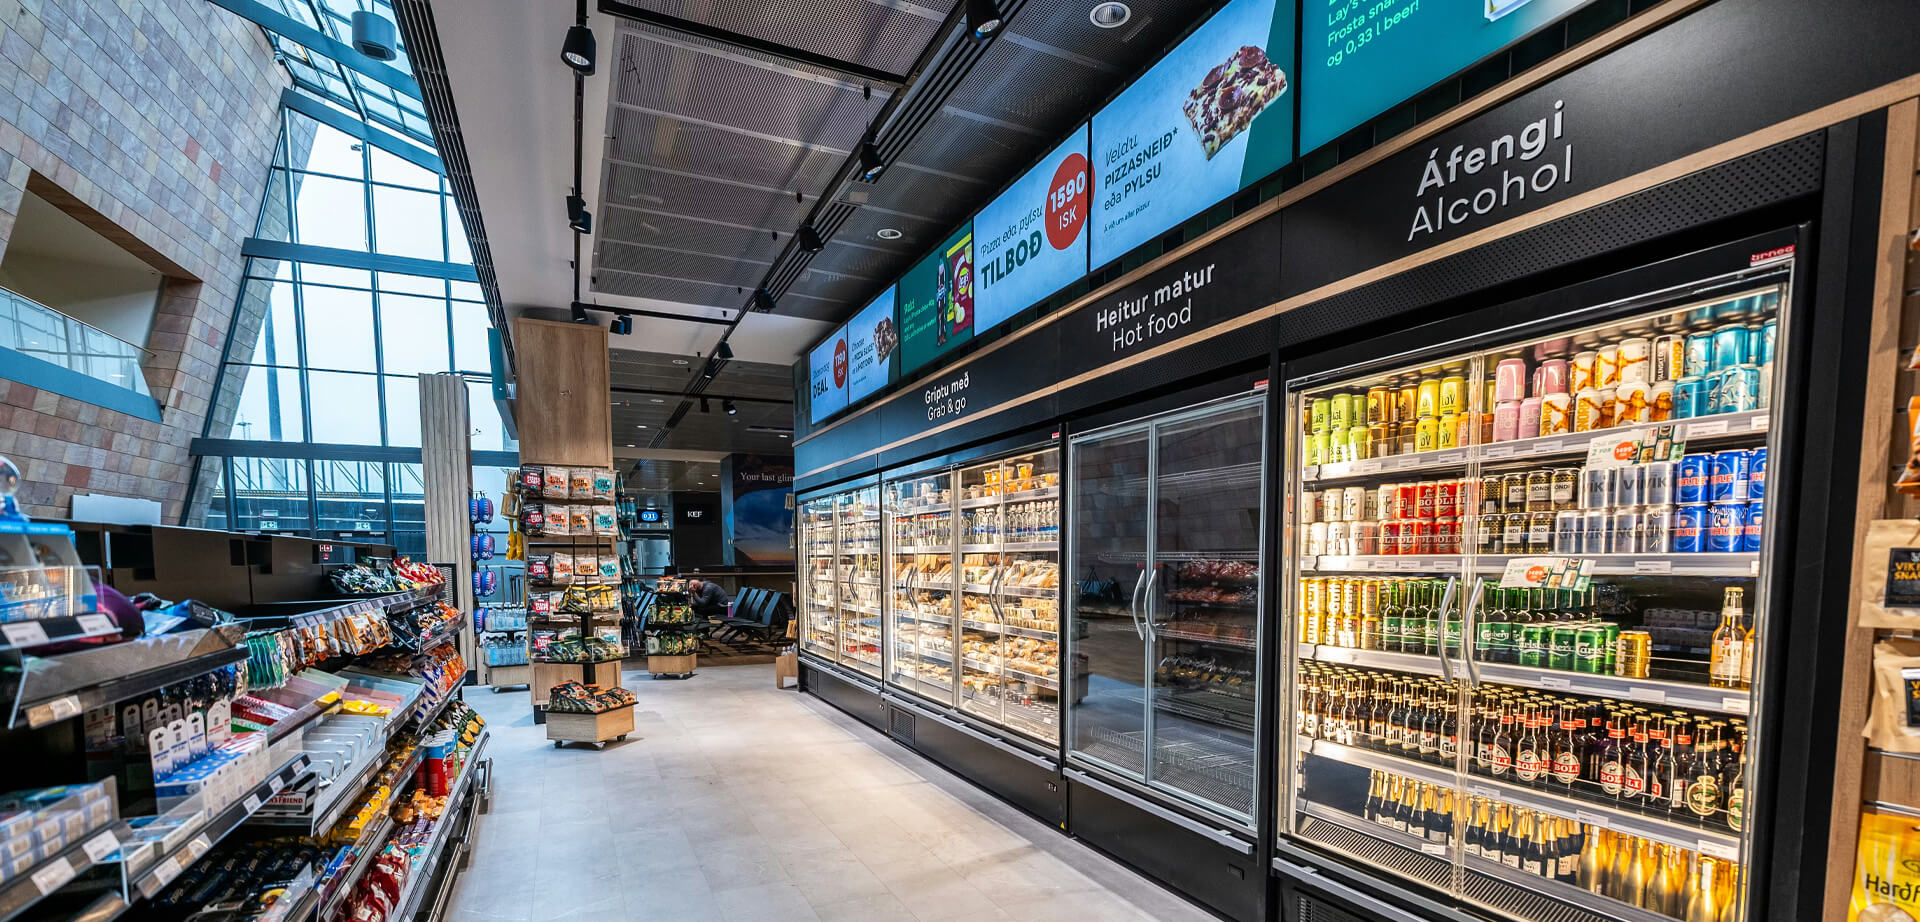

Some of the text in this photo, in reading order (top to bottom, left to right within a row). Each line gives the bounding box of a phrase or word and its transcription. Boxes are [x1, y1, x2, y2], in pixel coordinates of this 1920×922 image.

[1328, 0, 1396, 47] Frosta sna
[1327, 50, 1343, 67] og
[1346, 27, 1373, 54] 0,33
[1105, 134, 1138, 167] Veldu
[1416, 99, 1565, 198] Áfengi
[1050, 170, 1086, 214] 1590
[1104, 162, 1162, 211] eða PYLSU
[1407, 143, 1574, 242] Alcohol
[980, 205, 1043, 258] Pizza eða pylsu
[1059, 205, 1077, 231] ISK
[981, 230, 1043, 290] TILBOÐ
[1097, 263, 1215, 332] Heitur matur
[1113, 298, 1192, 352] Hot food
[813, 377, 829, 399] DEAL
[925, 371, 969, 404] Griptu með
[928, 397, 966, 421] Grab & go
[740, 472, 760, 481] Your
[761, 472, 775, 481] last
[1554, 765, 1578, 773] BOLI
